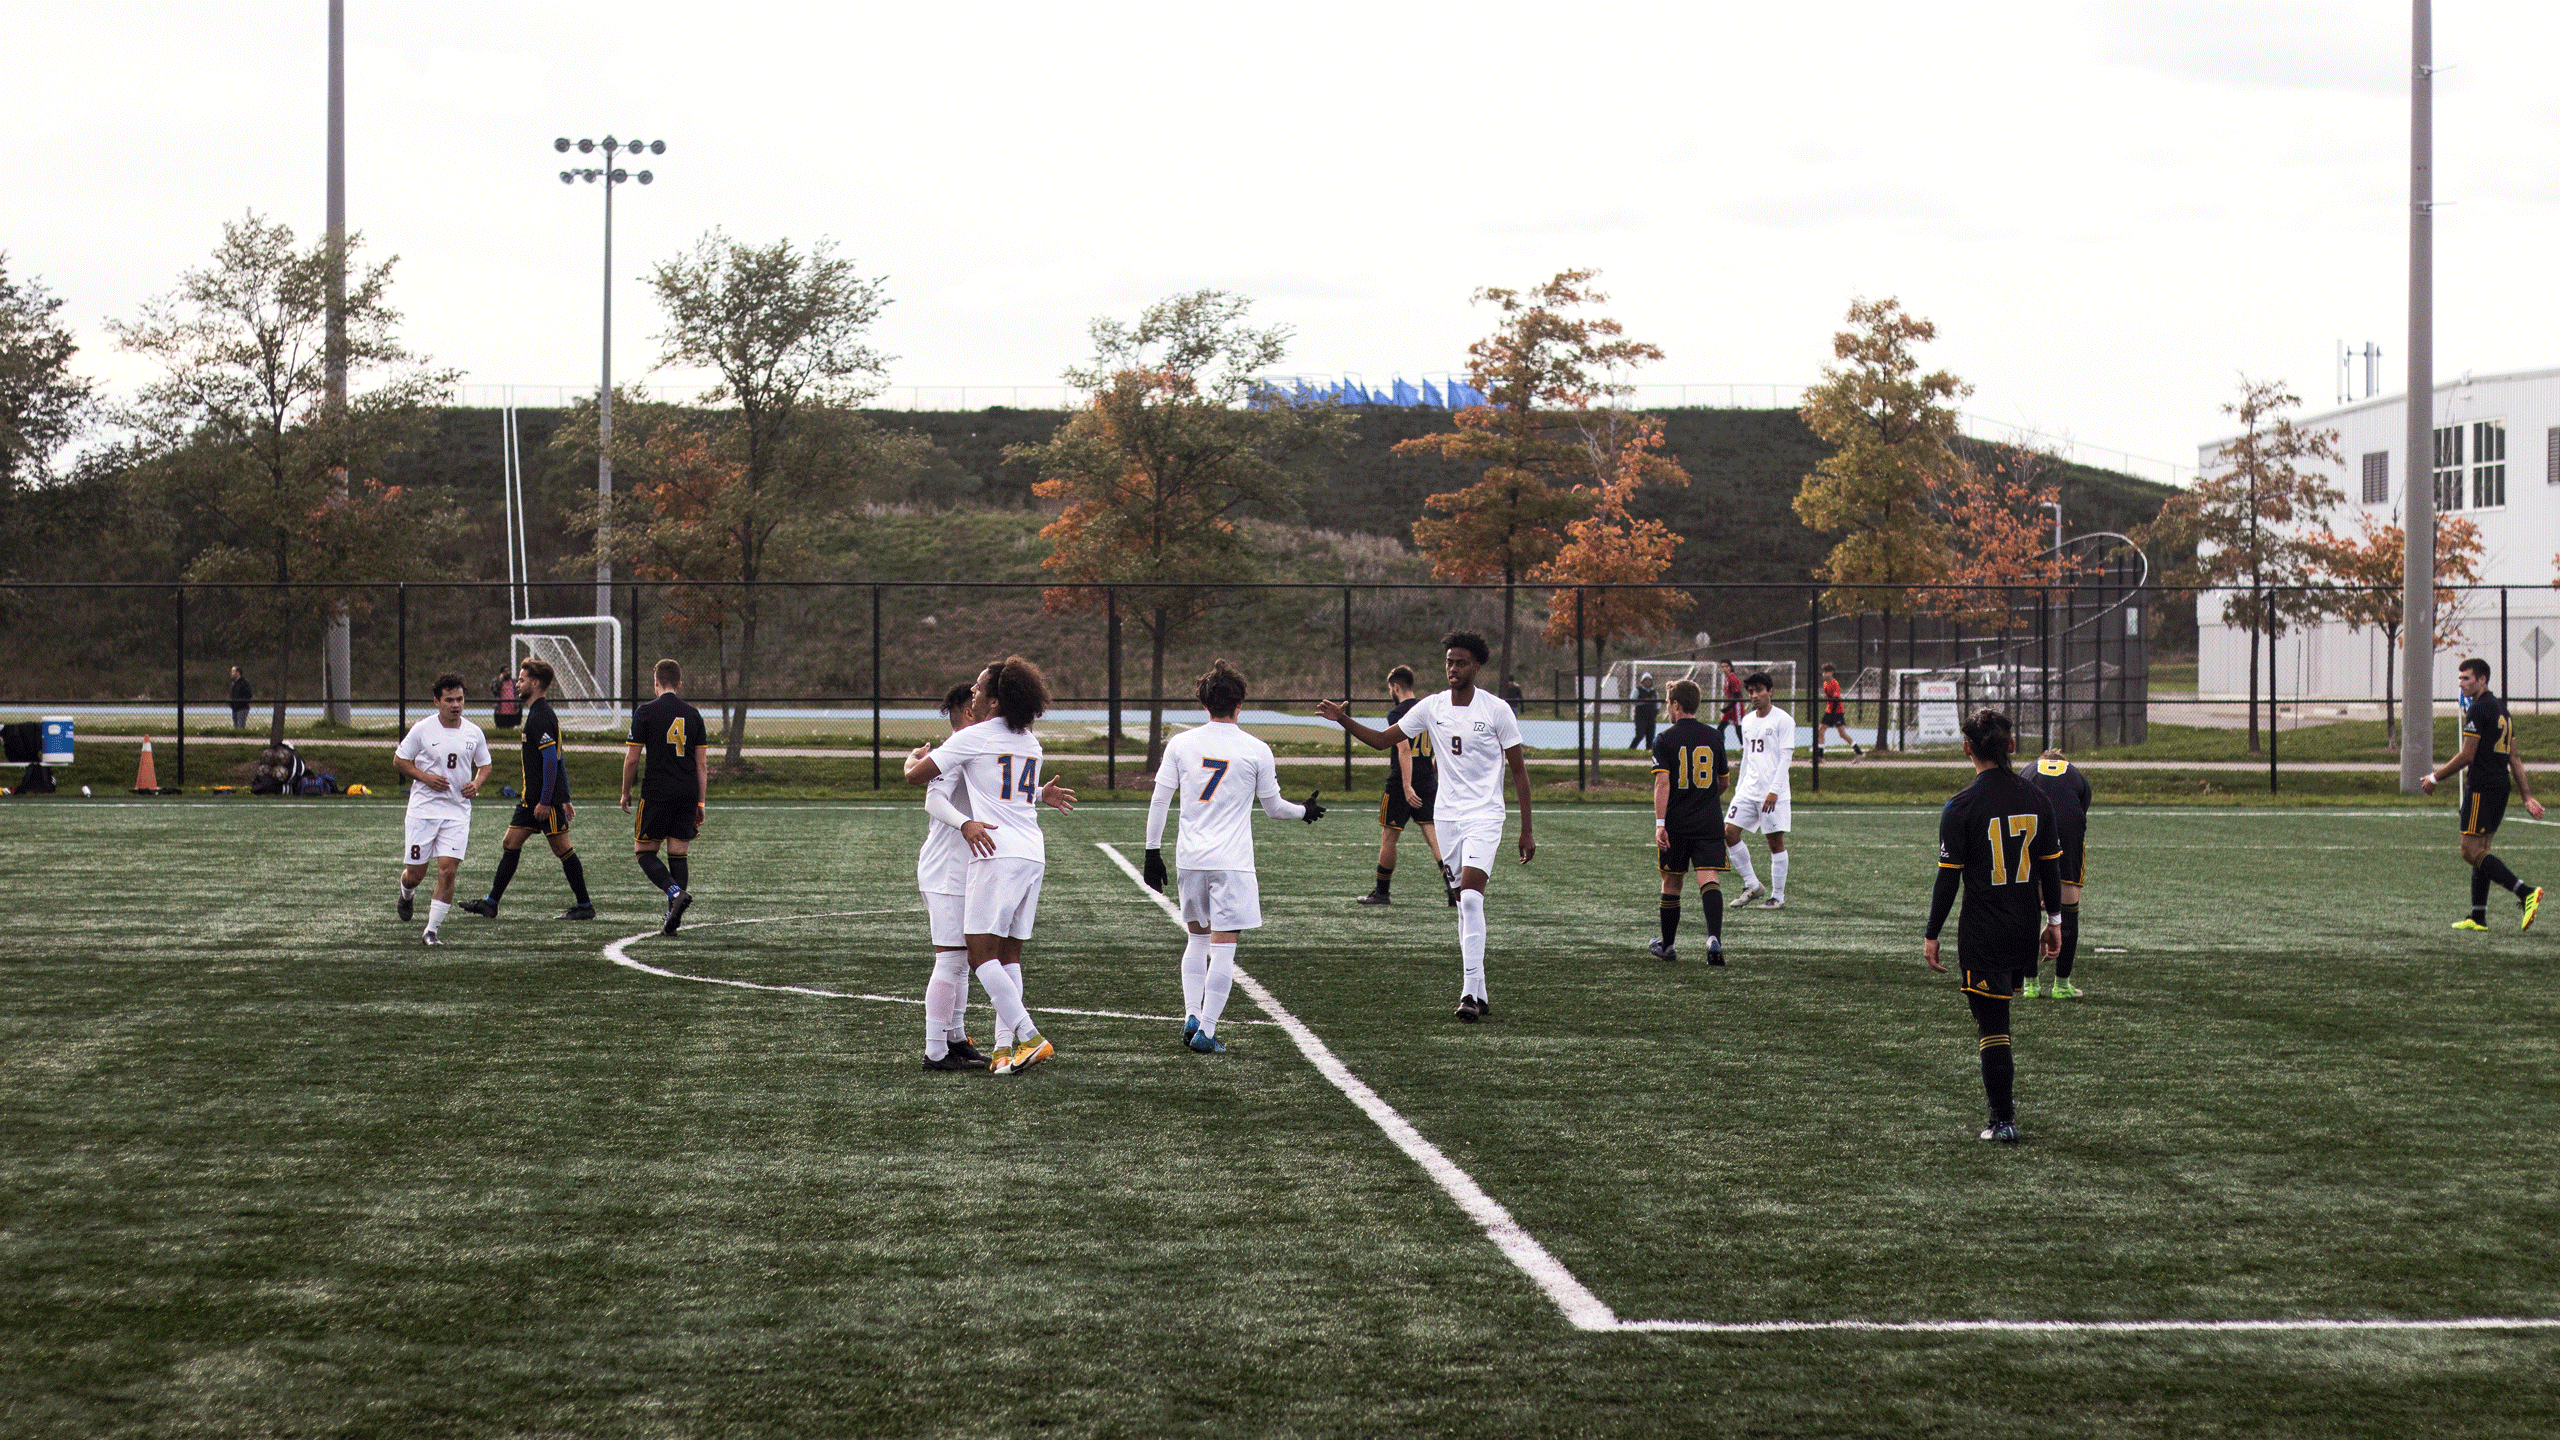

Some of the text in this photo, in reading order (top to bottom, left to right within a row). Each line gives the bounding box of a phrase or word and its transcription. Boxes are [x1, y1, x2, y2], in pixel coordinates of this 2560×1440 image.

[1474, 722, 1485, 731] R
[667, 717, 687, 757] 4
[1451, 736, 1462, 755] 9
[1751, 739, 1765, 753] 13
[447, 753, 457, 769] 8
[1678, 746, 1714, 789] 18
[996, 753, 1038, 805] 14
[1198, 757, 1229, 802] 7
[411, 845, 420, 860] 8
[1987, 813, 2038, 886] 17
[1444, 864, 1455, 882] 9
